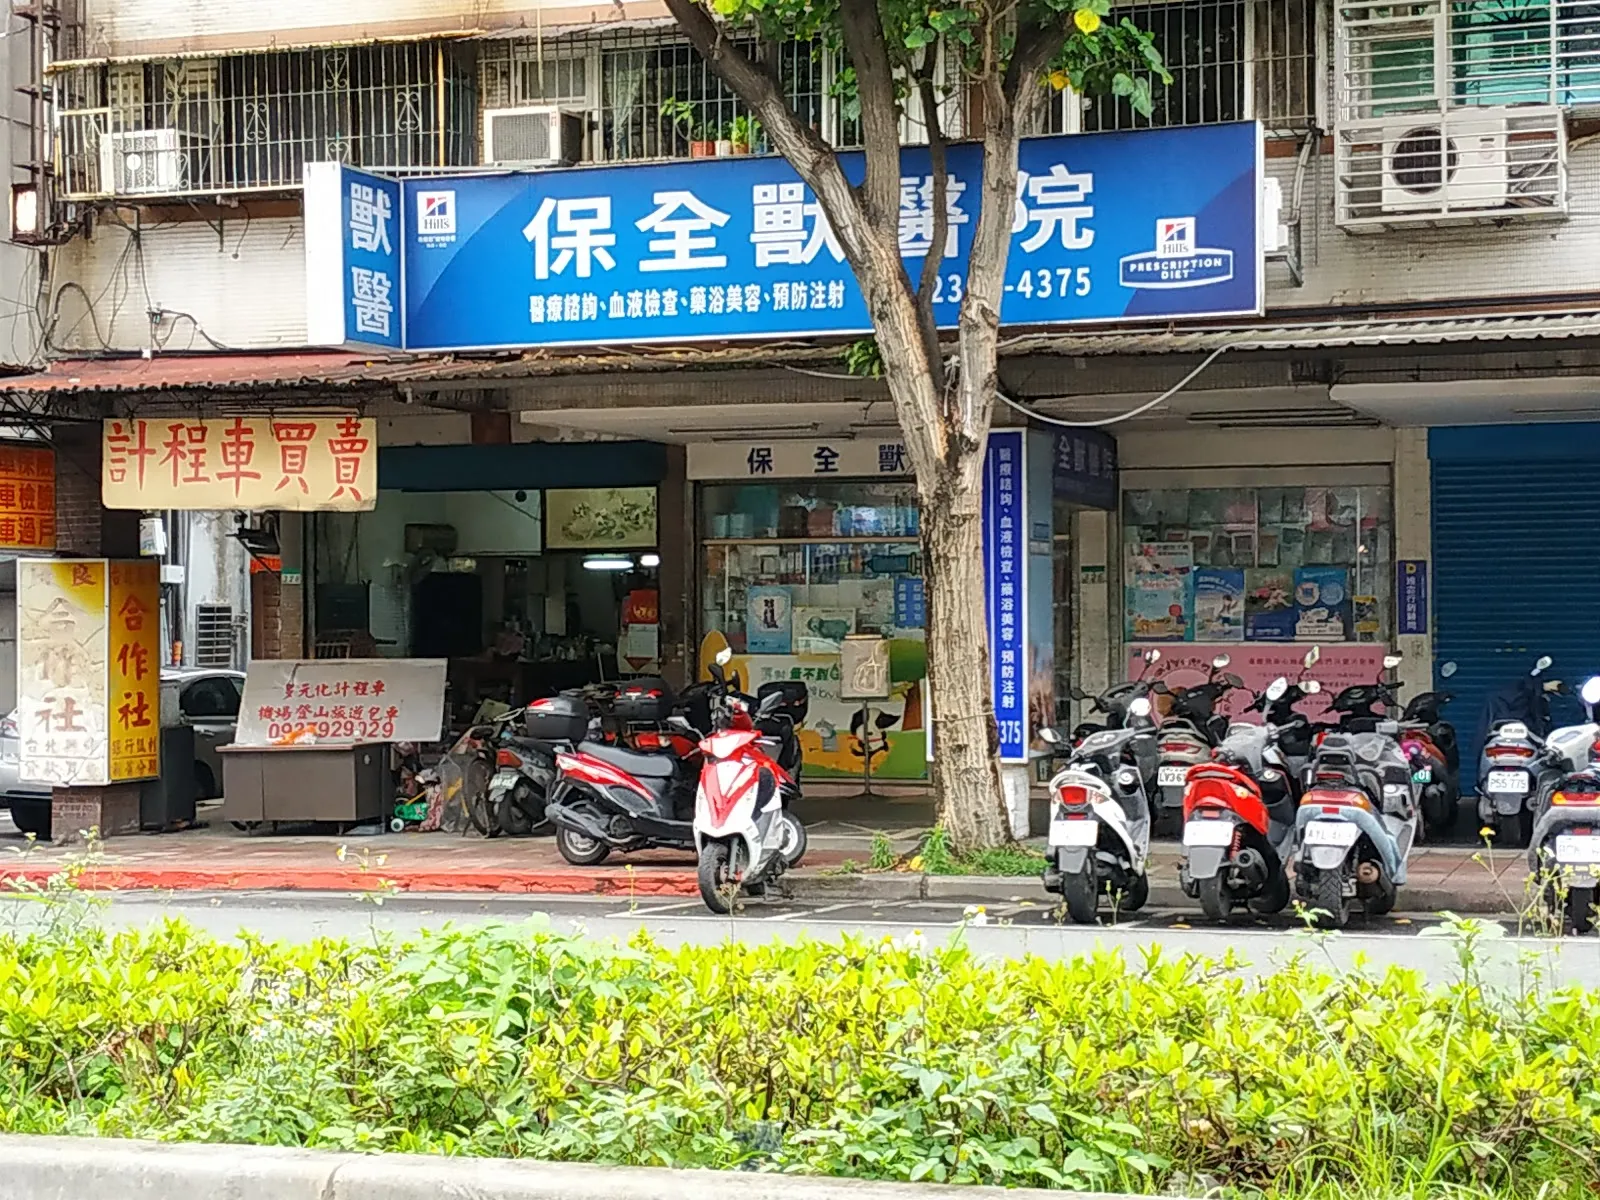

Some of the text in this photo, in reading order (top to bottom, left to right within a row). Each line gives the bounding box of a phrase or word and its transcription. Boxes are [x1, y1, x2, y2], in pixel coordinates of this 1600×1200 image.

[349, 182, 394, 337] 獸醫
[522, 164, 1095, 281] 保全獸醫院
[1163, 242, 1189, 254] Hill's
[1129, 258, 1223, 273] PRESCRIPTION
[107, 417, 369, 502] 計程車買賣
[117, 594, 152, 731] 合作社
[284, 680, 386, 700] 多元化計程車
